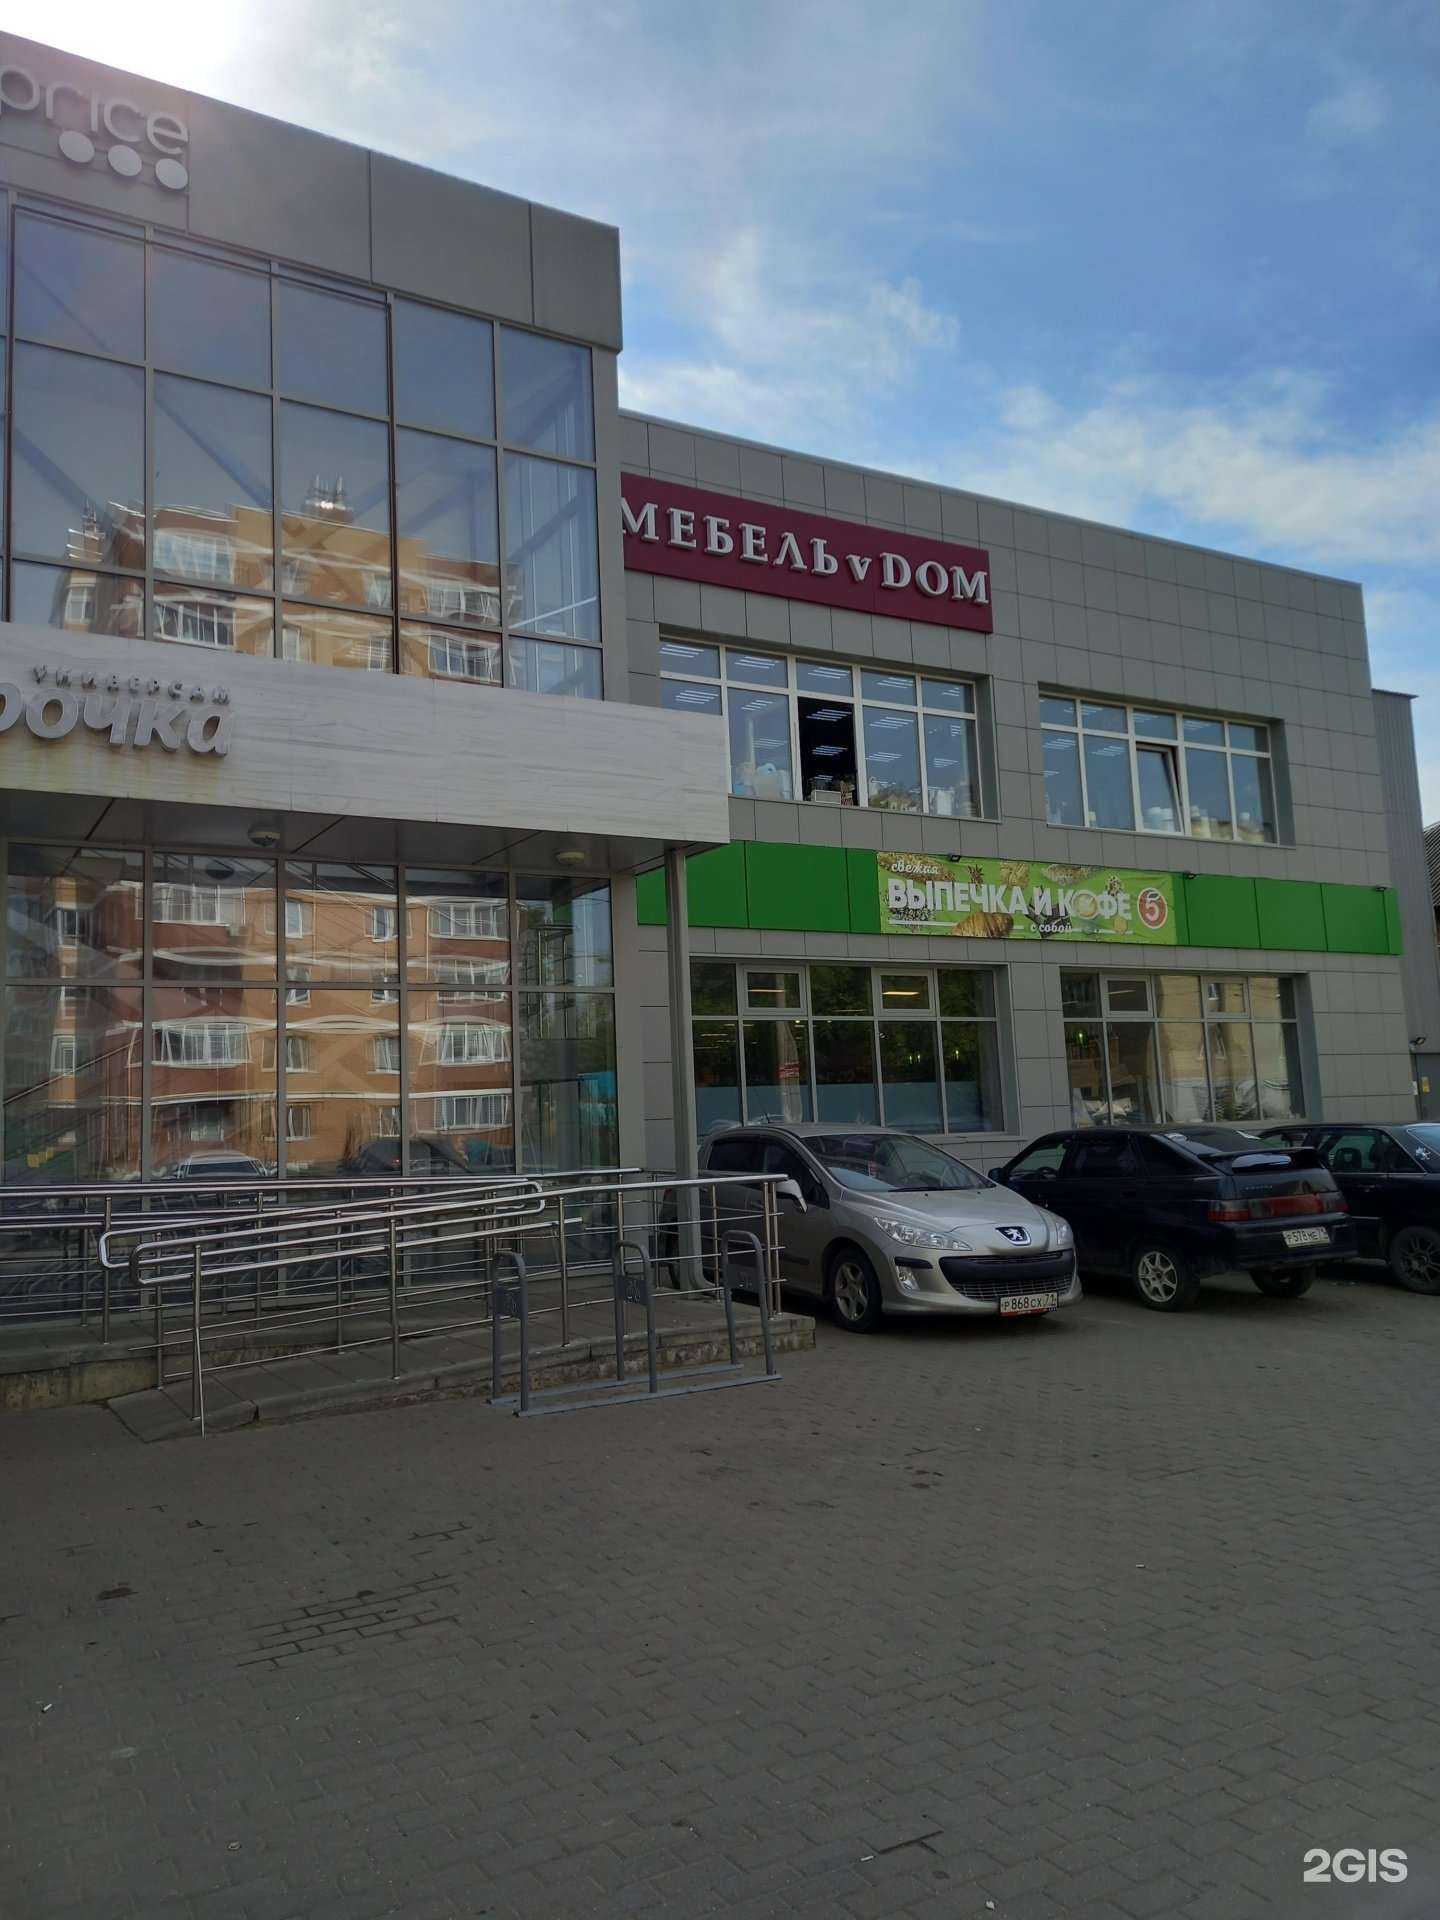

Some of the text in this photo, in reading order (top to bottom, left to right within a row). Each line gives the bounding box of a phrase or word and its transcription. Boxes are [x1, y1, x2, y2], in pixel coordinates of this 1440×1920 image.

[621, 497, 838, 576] МЕБЕЛЬ
[888, 878, 1132, 920] ВЫПЕЧКА И КОФЕ
